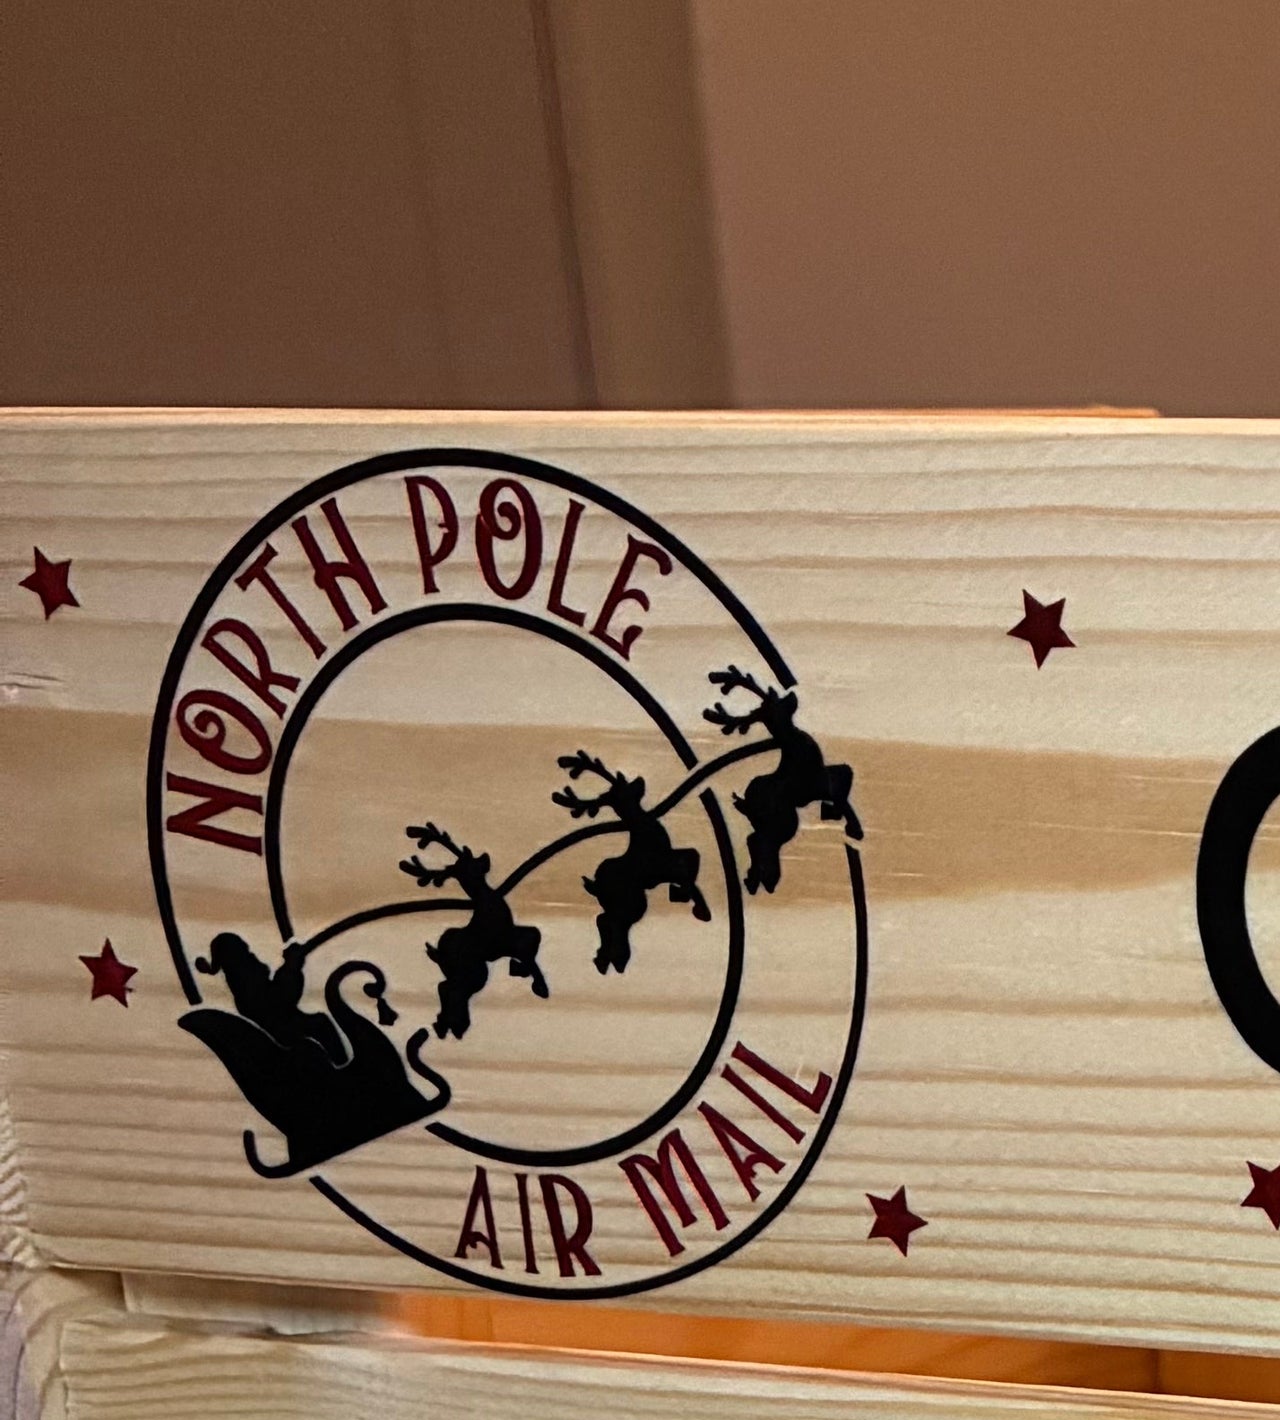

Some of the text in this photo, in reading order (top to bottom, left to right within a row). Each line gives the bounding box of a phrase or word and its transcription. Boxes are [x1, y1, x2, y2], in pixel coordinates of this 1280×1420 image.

[166, 475, 672, 856] NORTH POLE
[454, 1041, 833, 1278] AIR MAIL
